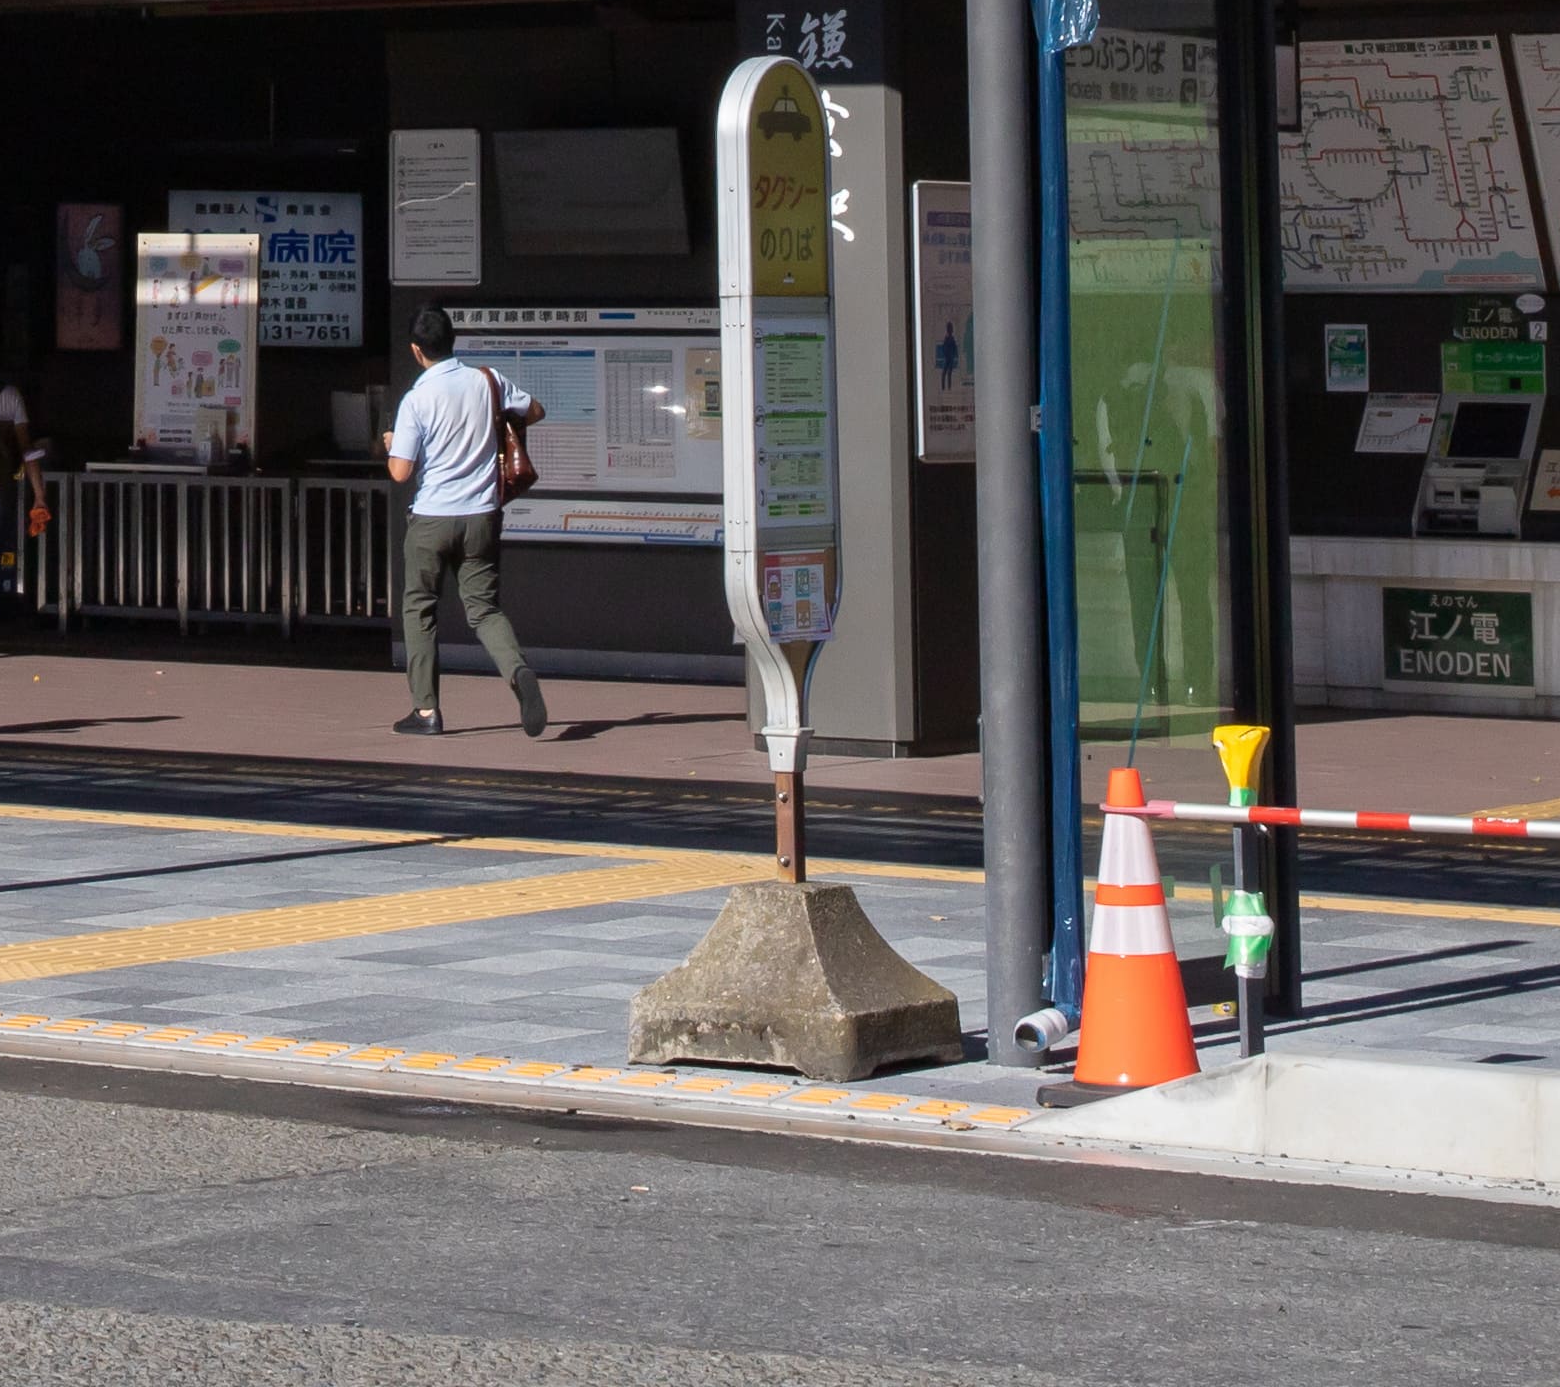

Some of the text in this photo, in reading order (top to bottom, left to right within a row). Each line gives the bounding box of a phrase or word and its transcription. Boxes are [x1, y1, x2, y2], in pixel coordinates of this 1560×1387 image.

[1067, 80, 1103, 100] ickets
[753, 174, 819, 211] タクシー
[267, 228, 357, 264] 病院
[759, 225, 817, 262] のりば
[1462, 325, 1519, 340] ENODEN
[1534, 322, 1544, 340] 2
[1428, 594, 1479, 609] えのでん
[1408, 609, 1501, 646] 江ノ電
[1399, 648, 1512, 679] ENODEN
